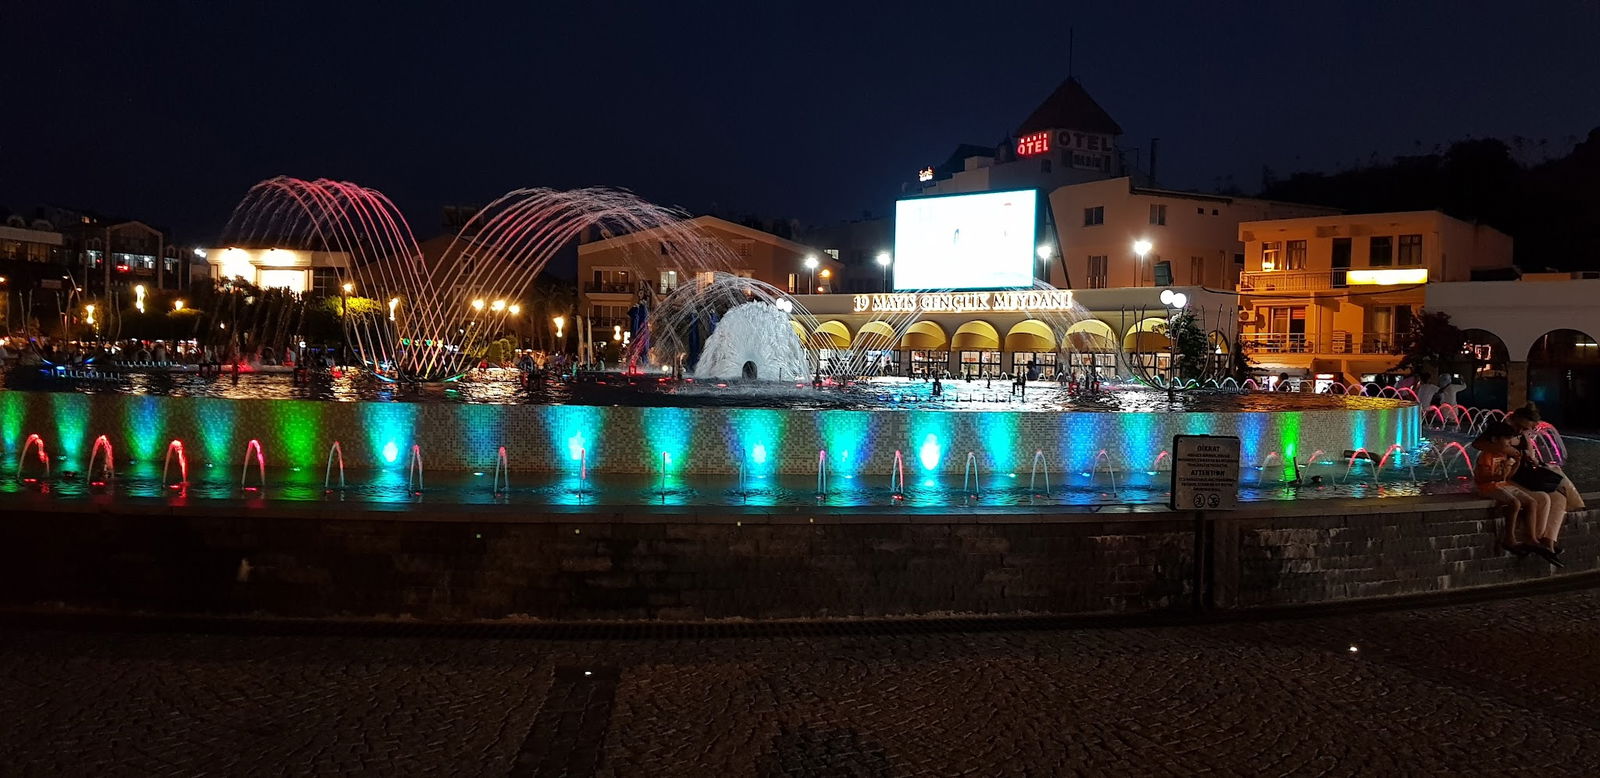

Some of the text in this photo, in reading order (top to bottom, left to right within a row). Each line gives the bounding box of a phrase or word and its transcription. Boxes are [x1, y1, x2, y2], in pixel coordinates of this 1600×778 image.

[1017, 139, 1049, 155] OTEL
[1058, 131, 1113, 151] OTEL
[854, 291, 1073, 313] 19 MAYIS GENÇLİK MEYDANI
